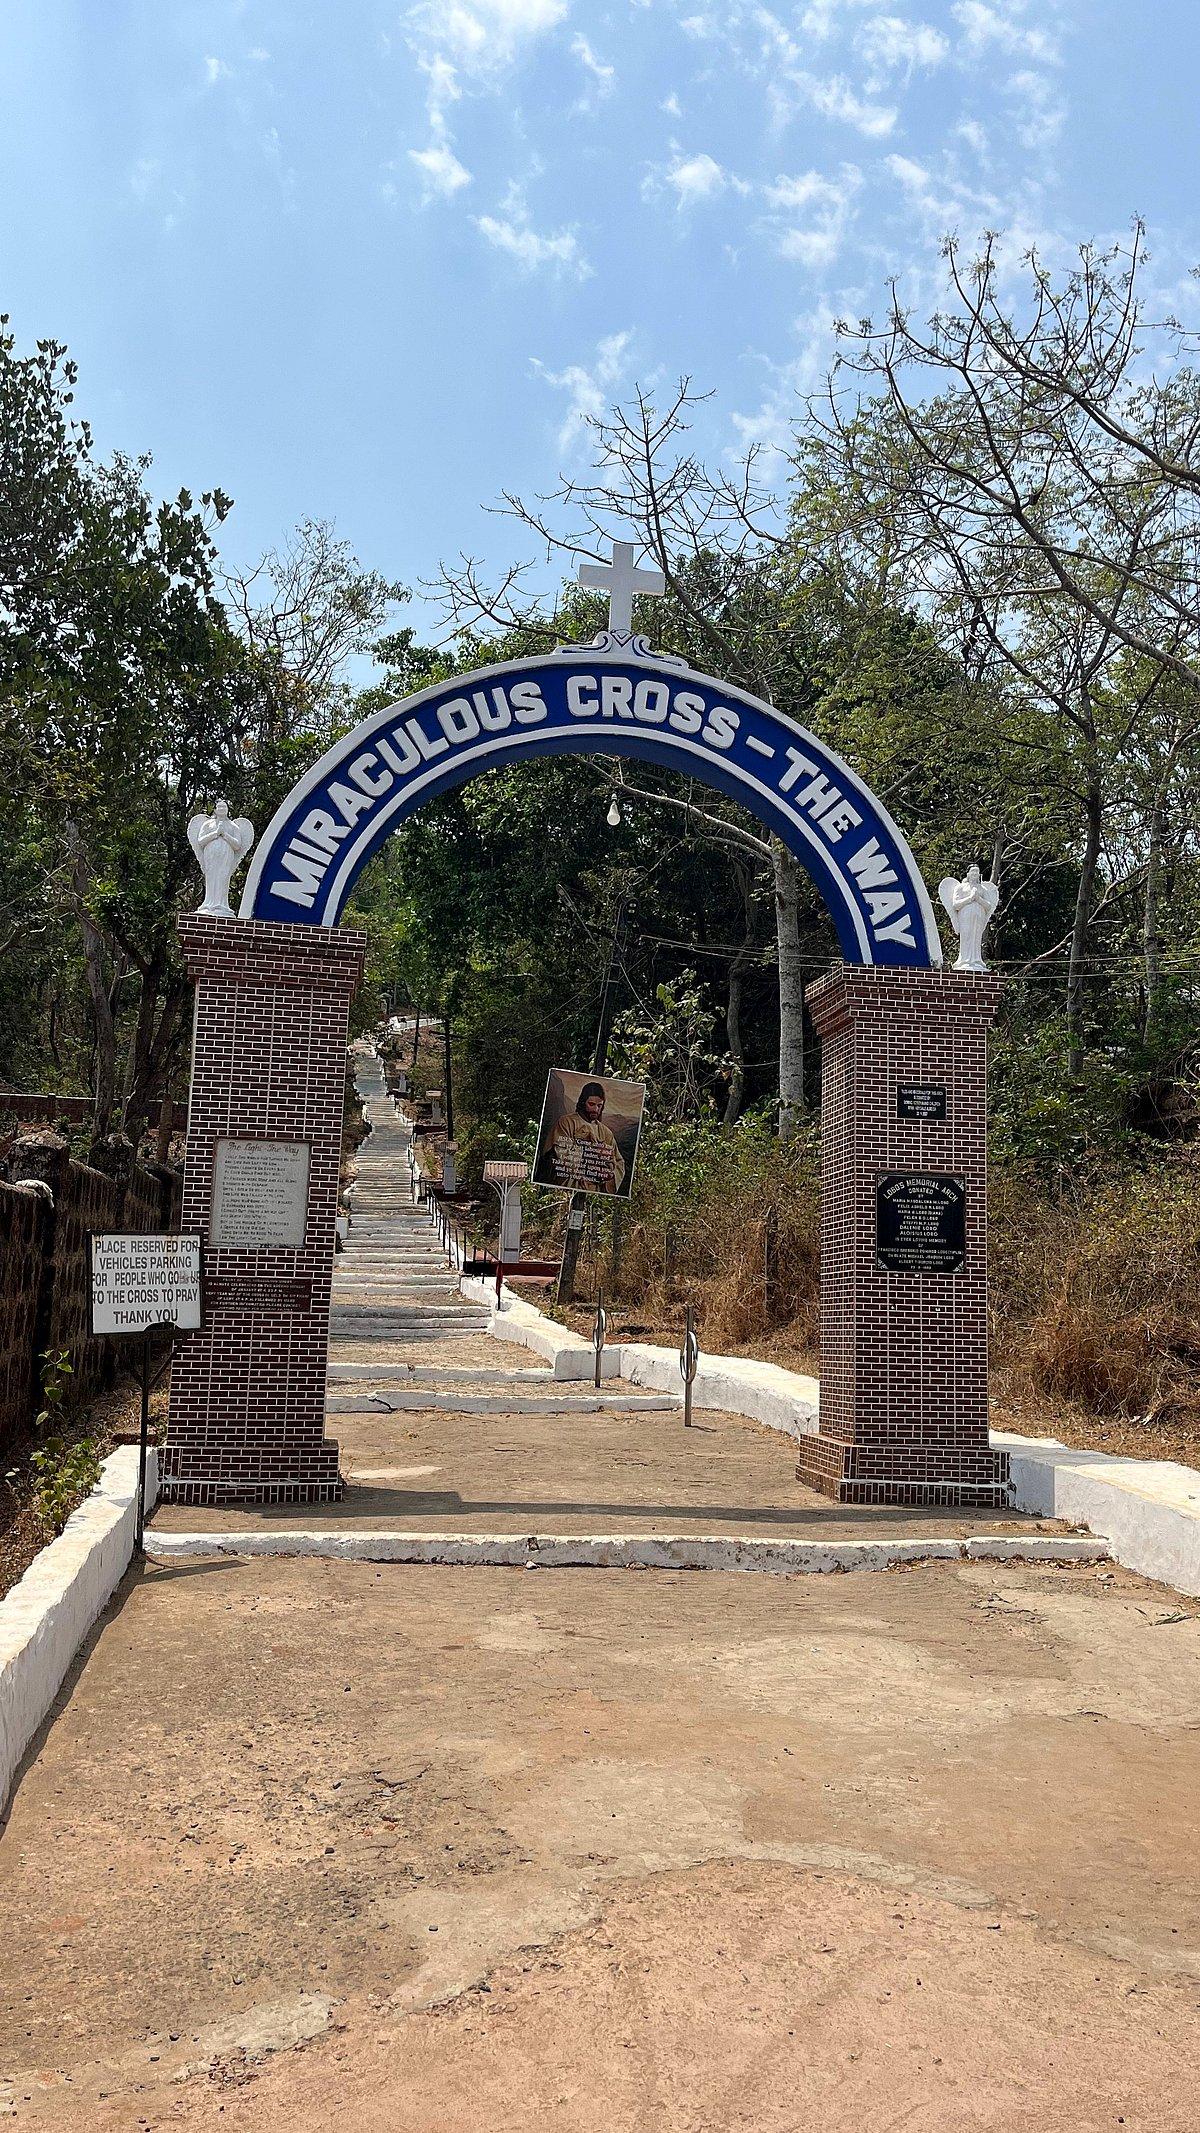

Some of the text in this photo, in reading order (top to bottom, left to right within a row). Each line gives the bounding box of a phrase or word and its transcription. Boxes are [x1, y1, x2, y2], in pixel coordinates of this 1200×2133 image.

[270, 681, 548, 910] MIRACULOUS
[566, 675, 741, 750] CROSS
[778, 748, 863, 844] THE
[846, 836, 917, 949] WAY
[906, 1178, 939, 1190] MEMORIAL
[941, 1186, 959, 1203] ARCH
[908, 1187, 933, 1195] DONATED
[95, 1240, 199, 1254] PLACE RESERVED FOR
[99, 1256, 192, 1269] VEHICLES PARKING
[114, 1271, 146, 1285] PEOPLE
[147, 1271, 166, 1285] WHO
[168, 1271, 179, 1285] GO
[92, 1288, 198, 1304] TO THE CROSS TO PRAY
[113, 1309, 178, 1324] THANK YOU
